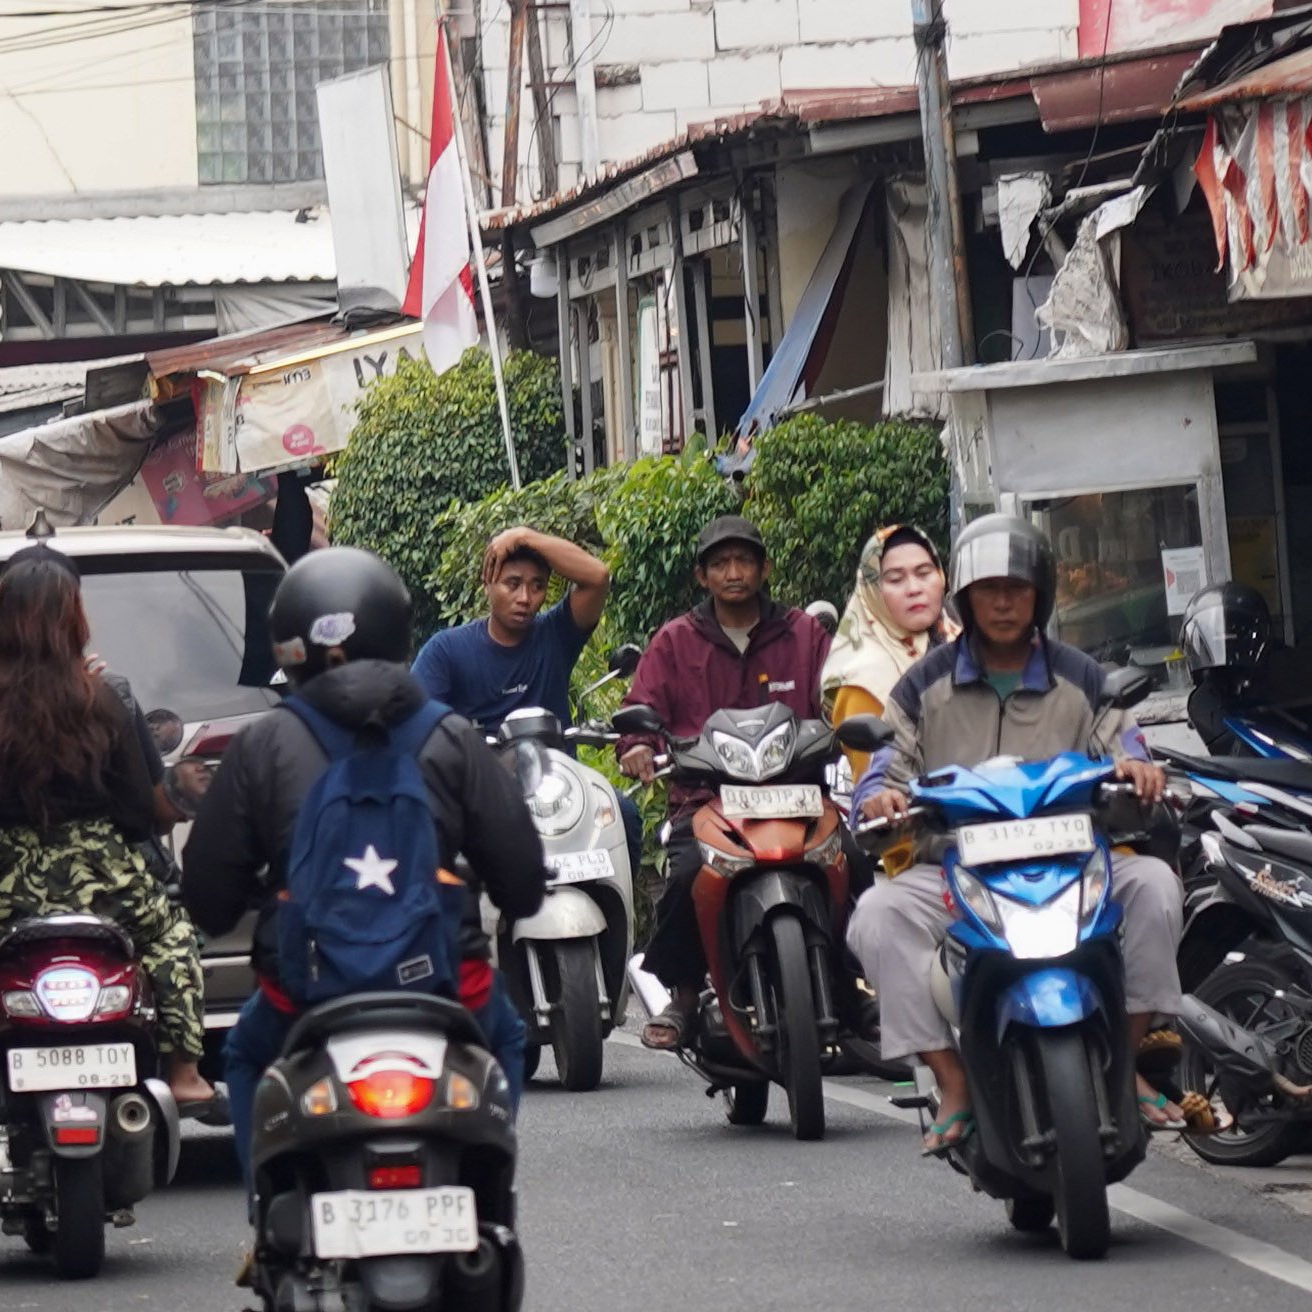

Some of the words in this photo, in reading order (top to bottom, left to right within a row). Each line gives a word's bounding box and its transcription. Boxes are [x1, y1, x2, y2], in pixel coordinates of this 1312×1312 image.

[13, 1053, 23, 1070] B
[37, 1049, 85, 1067] 5088
[321, 1200, 335, 1225] B
